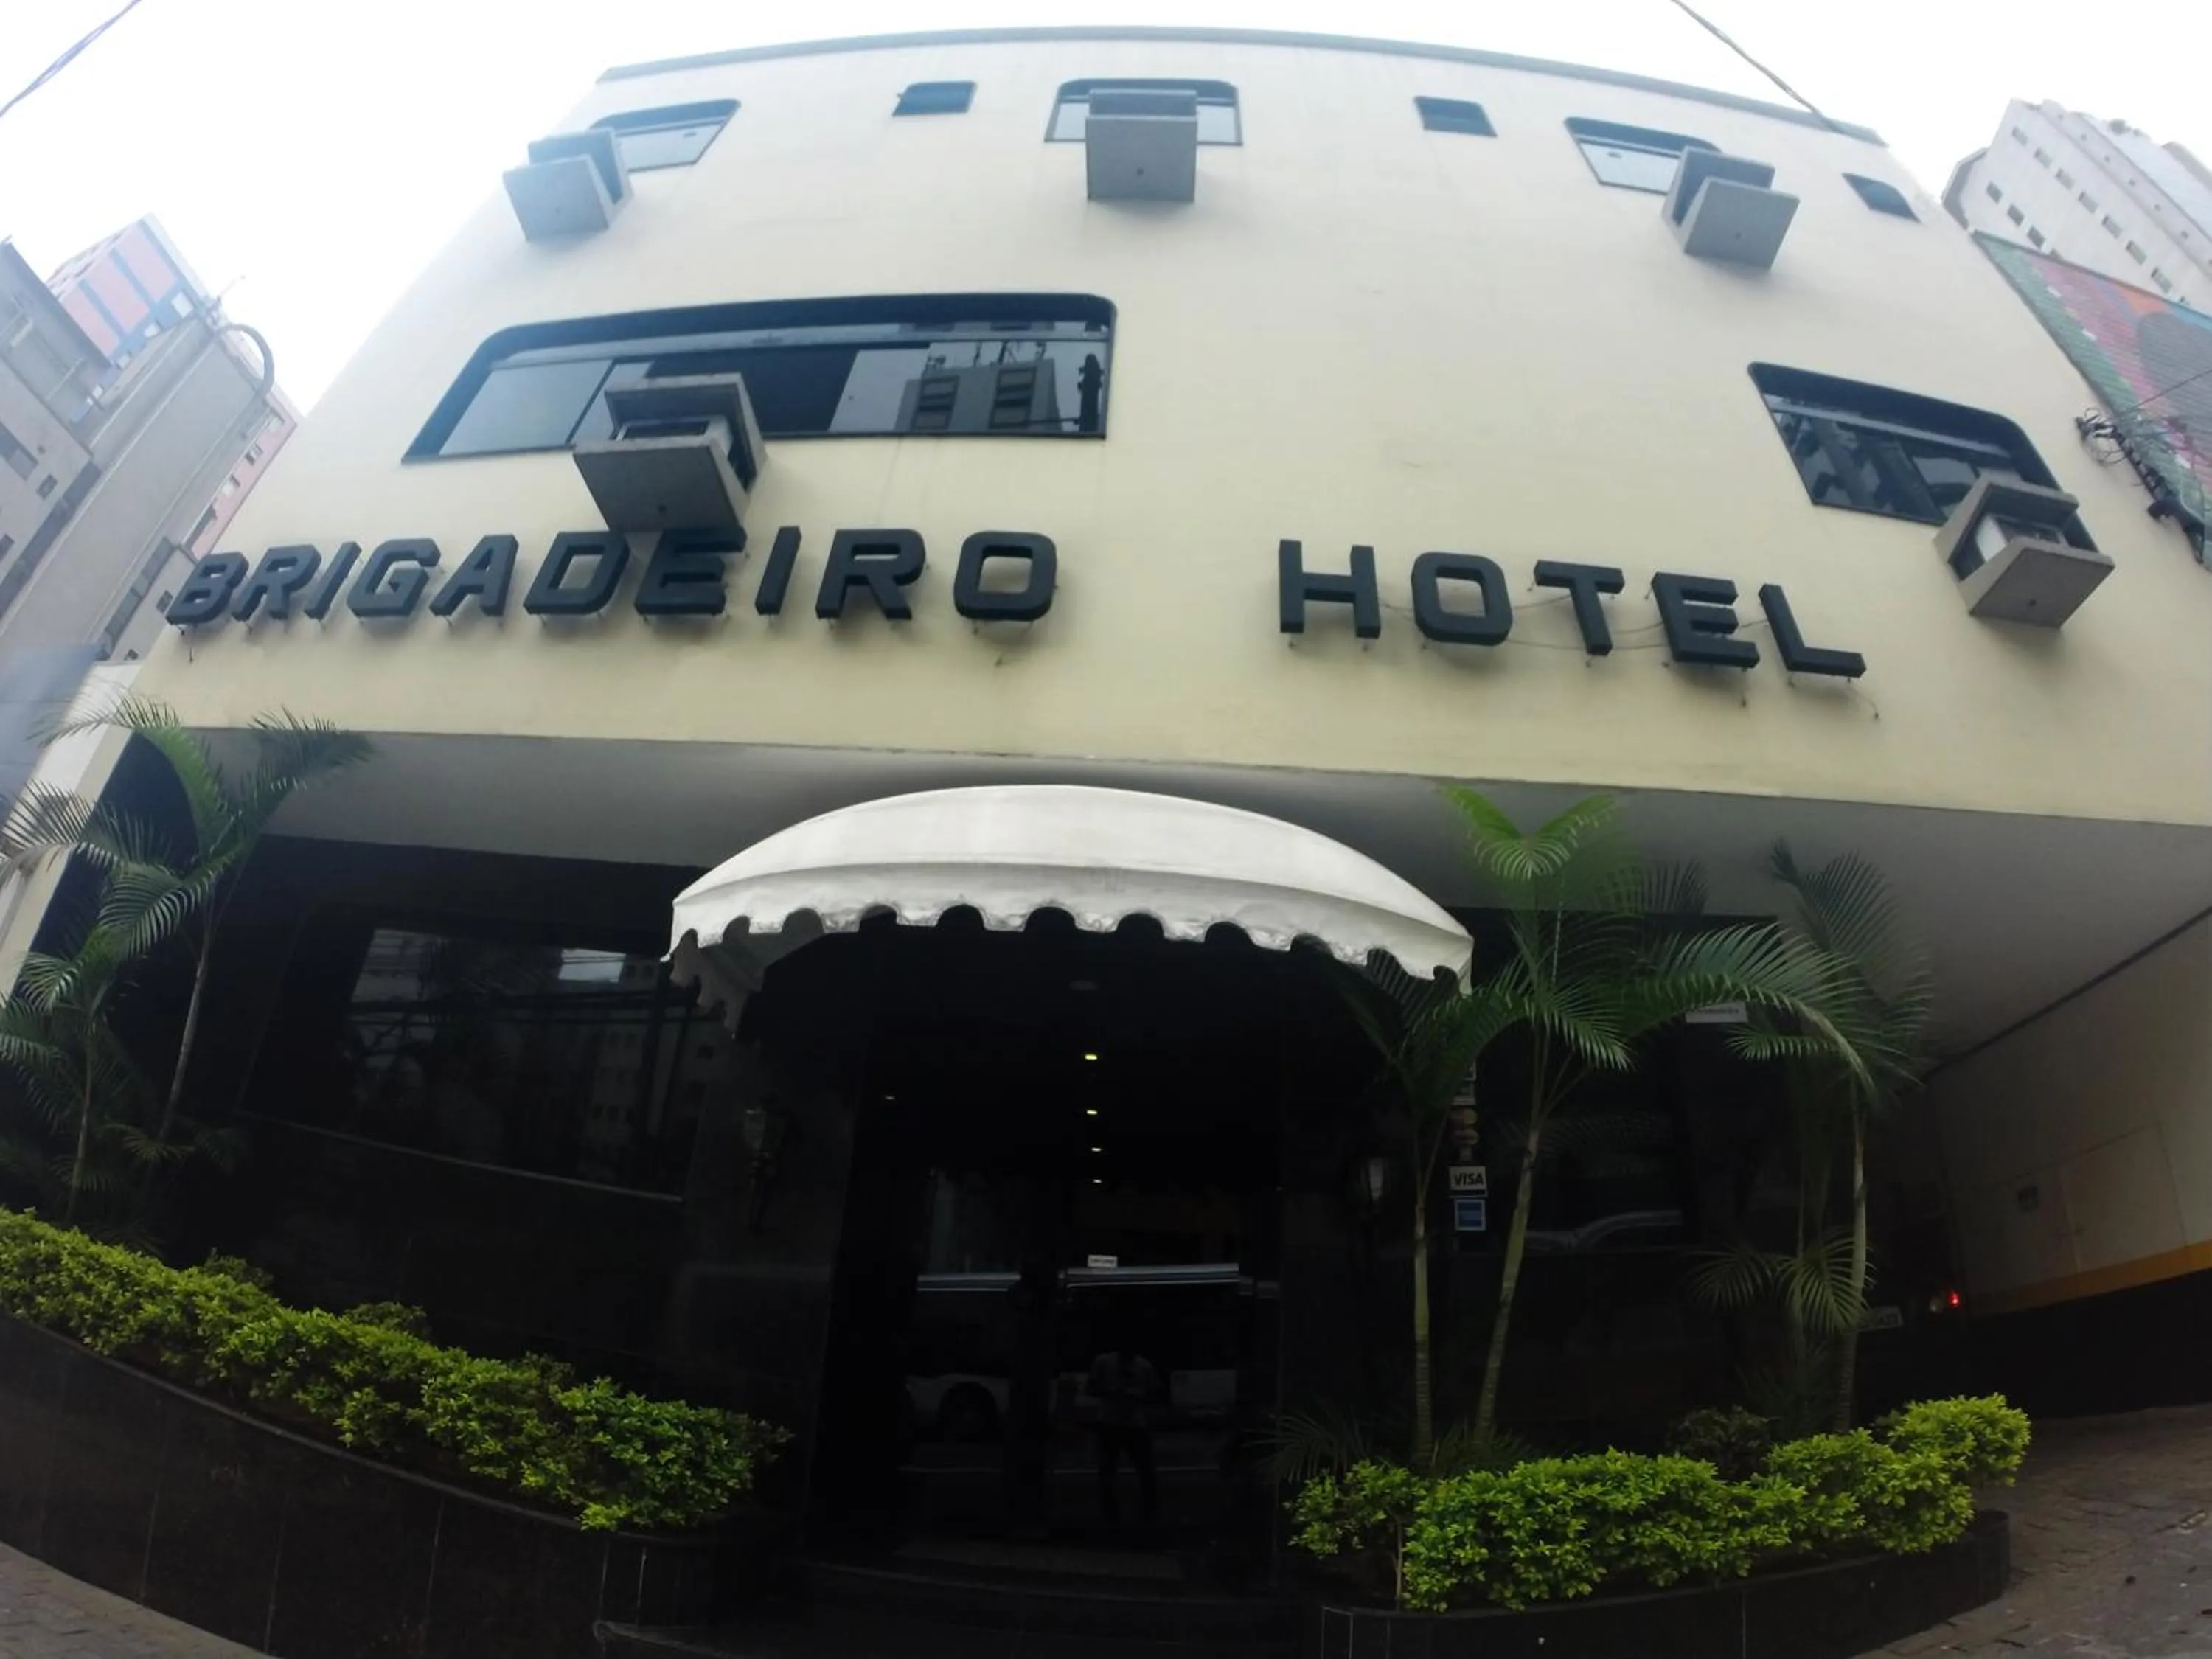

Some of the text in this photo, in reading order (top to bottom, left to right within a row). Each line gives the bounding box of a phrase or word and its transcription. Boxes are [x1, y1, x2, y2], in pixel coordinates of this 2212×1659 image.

[165, 526, 1866, 678] BRIGADEIRO HOTEL
[1454, 1172, 1485, 1186] VISA
